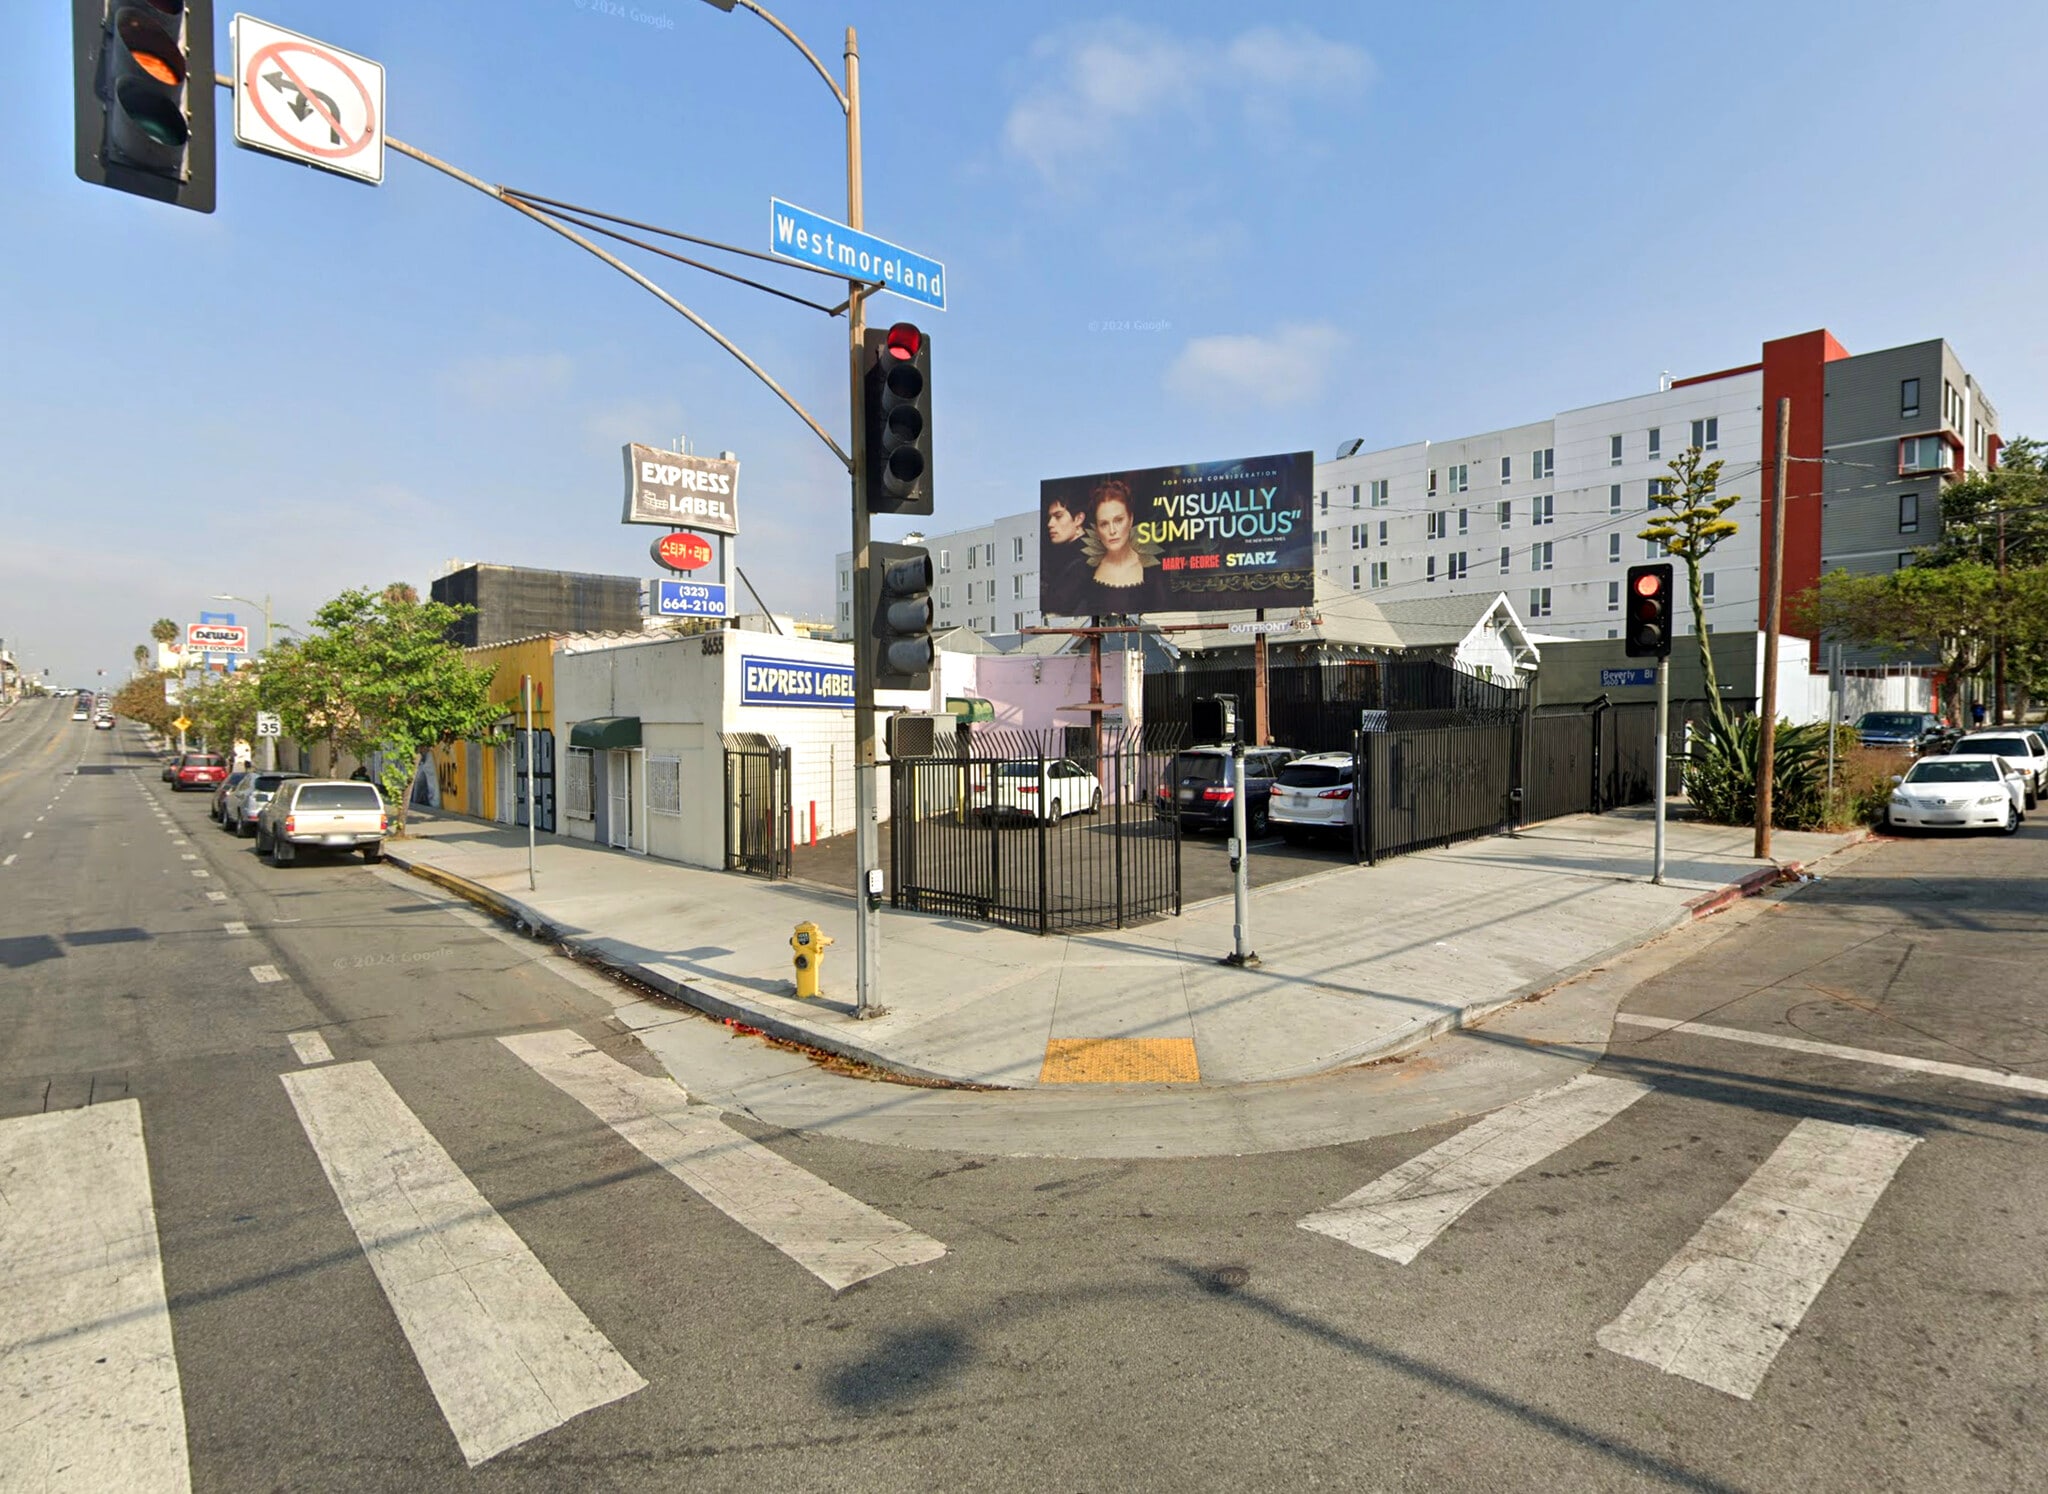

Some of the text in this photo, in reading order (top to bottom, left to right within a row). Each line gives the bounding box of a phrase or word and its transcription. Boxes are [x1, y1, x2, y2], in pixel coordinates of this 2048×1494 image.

[777, 213, 941, 297] Westmoreland
[641, 461, 730, 495] EXPRESS
[1182, 476, 1203, 484] YOUR
[1207, 470, 1277, 482] CONSIDERATION
[669, 493, 731, 520] LABEL
[1162, 554, 1220, 570] MARY GEORGE
[1226, 551, 1277, 567] STARZ
[679, 585, 709, 600] (323)
[663, 598, 724, 613] 664-2100
[195, 630, 239, 640] DEWEY
[1230, 622, 1288, 633] OUTFRONT
[701, 637, 724, 656] 3655
[747, 666, 855, 698] EXPRESS LABEL
[1603, 670, 1635, 681] Beverly
[260, 723, 279, 734] 35
